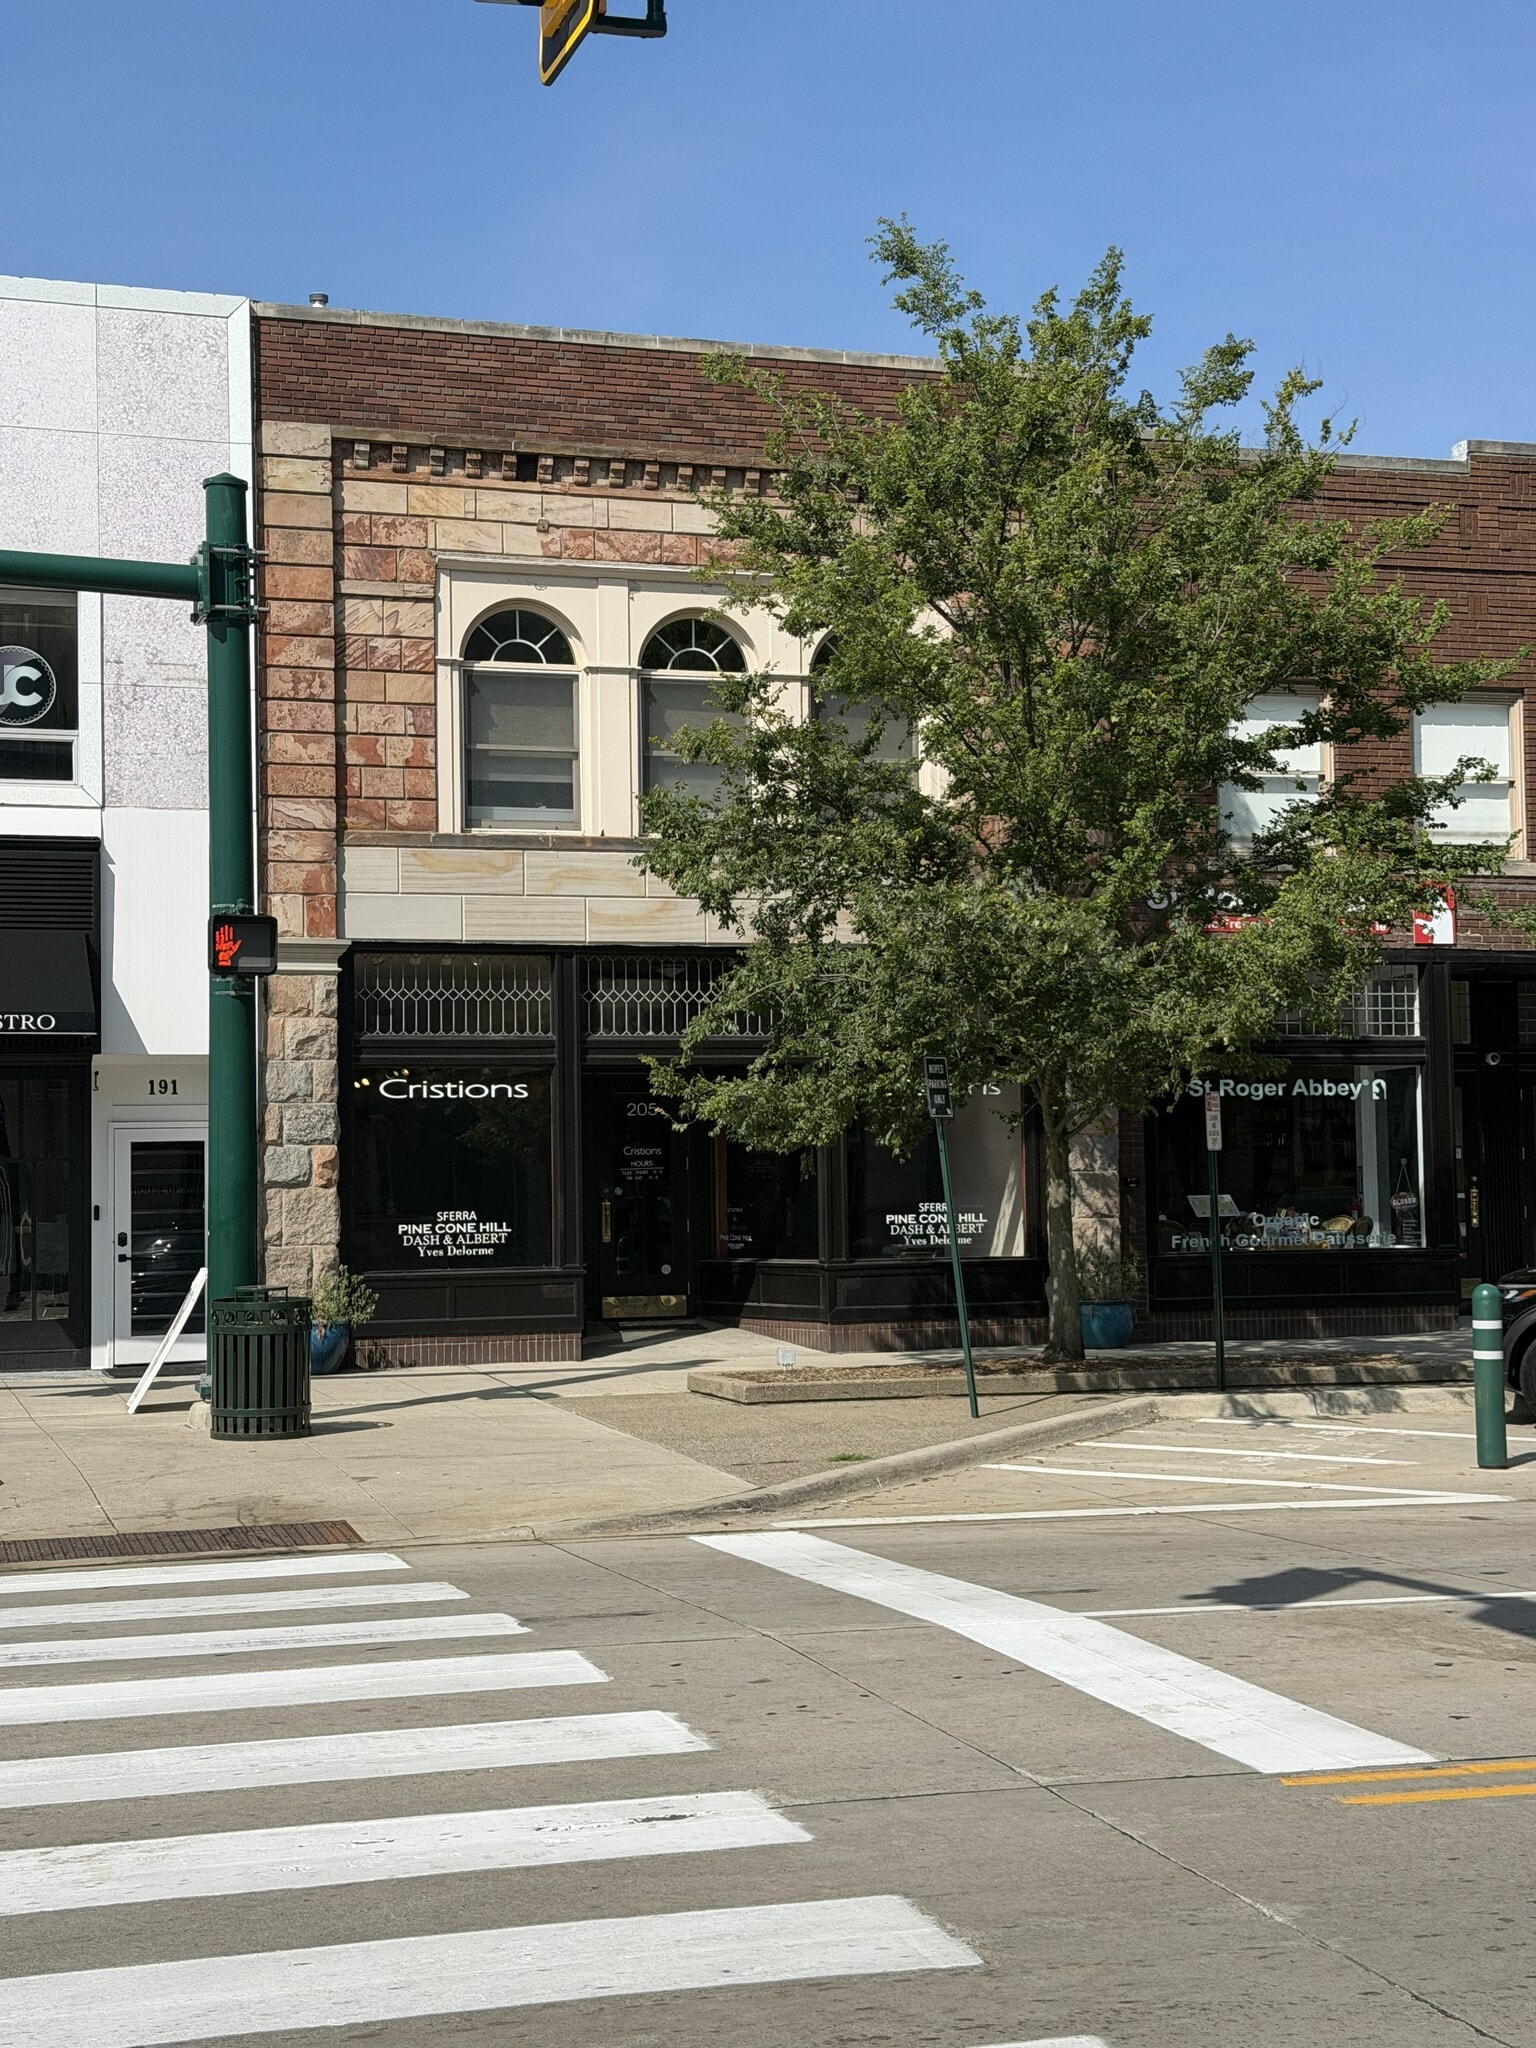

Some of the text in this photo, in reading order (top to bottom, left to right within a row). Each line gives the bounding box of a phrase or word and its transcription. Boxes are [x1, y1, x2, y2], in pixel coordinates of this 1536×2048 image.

[148, 1079, 179, 1095] 191
[379, 1078, 529, 1099] Cristions
[1219, 1079, 1287, 1101] Roger
[627, 1102, 658, 1117] 205
[623, 1146, 662, 1156] Cristions
[630, 1160, 653, 1168] HOURS
[918, 1202, 948, 1212] SFERR
[436, 1210, 477, 1222] SFERRA
[885, 1212, 988, 1225] PINE CON HILL
[1252, 1212, 1320, 1229] Organic
[398, 1221, 512, 1235] PINE CONE HILL
[890, 1224, 924, 1235] DASH
[926, 1224, 936, 1234] &
[403, 1233, 508, 1246] DASH & ALBERT
[903, 1235, 927, 1246] Yves
[1171, 1234, 1230, 1248] Frenh
[1235, 1233, 1309, 1246] Gourmet
[1314, 1231, 1397, 1246] Patisserie
[417, 1245, 494, 1257] Yves Delorme
